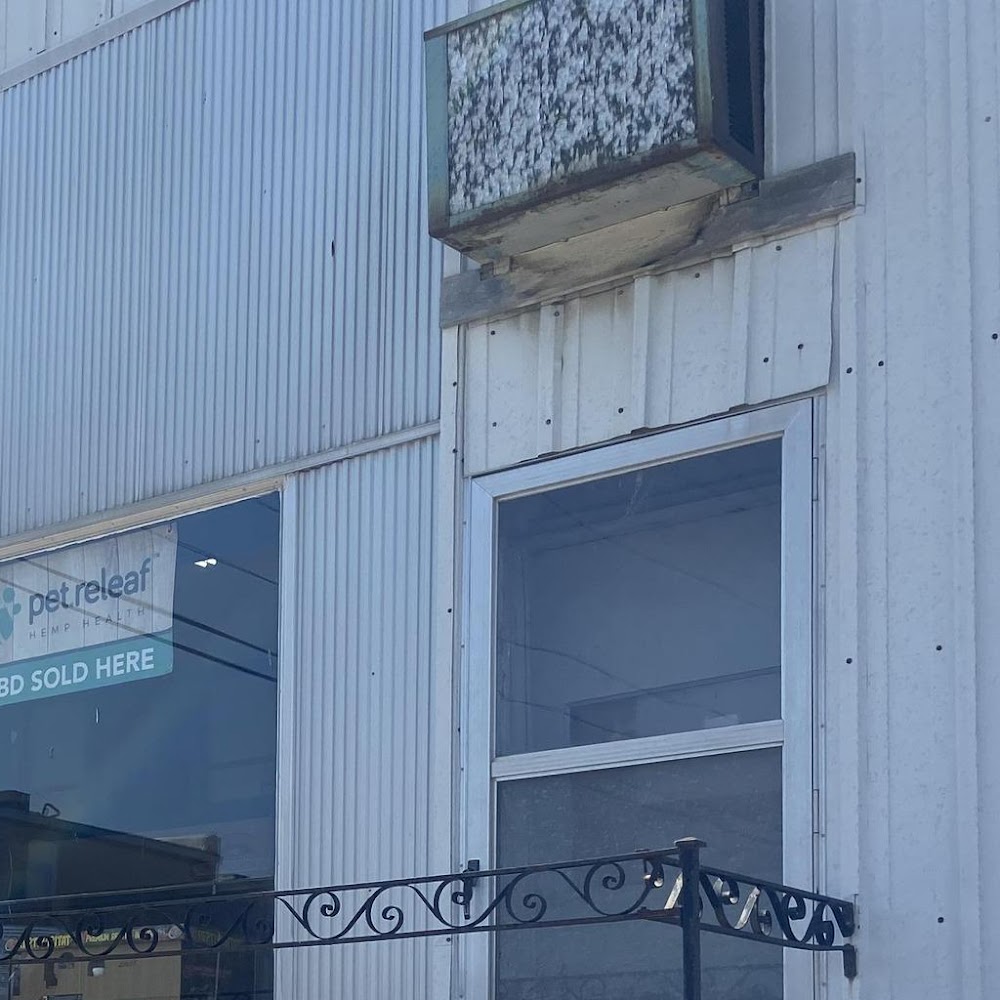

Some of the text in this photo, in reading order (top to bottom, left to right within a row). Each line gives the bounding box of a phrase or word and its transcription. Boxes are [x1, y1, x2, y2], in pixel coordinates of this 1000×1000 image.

[29, 607, 146, 640] HEMP HEALTH
[31, 662, 88, 692] SOLD
[96, 647, 155, 680] HERE
